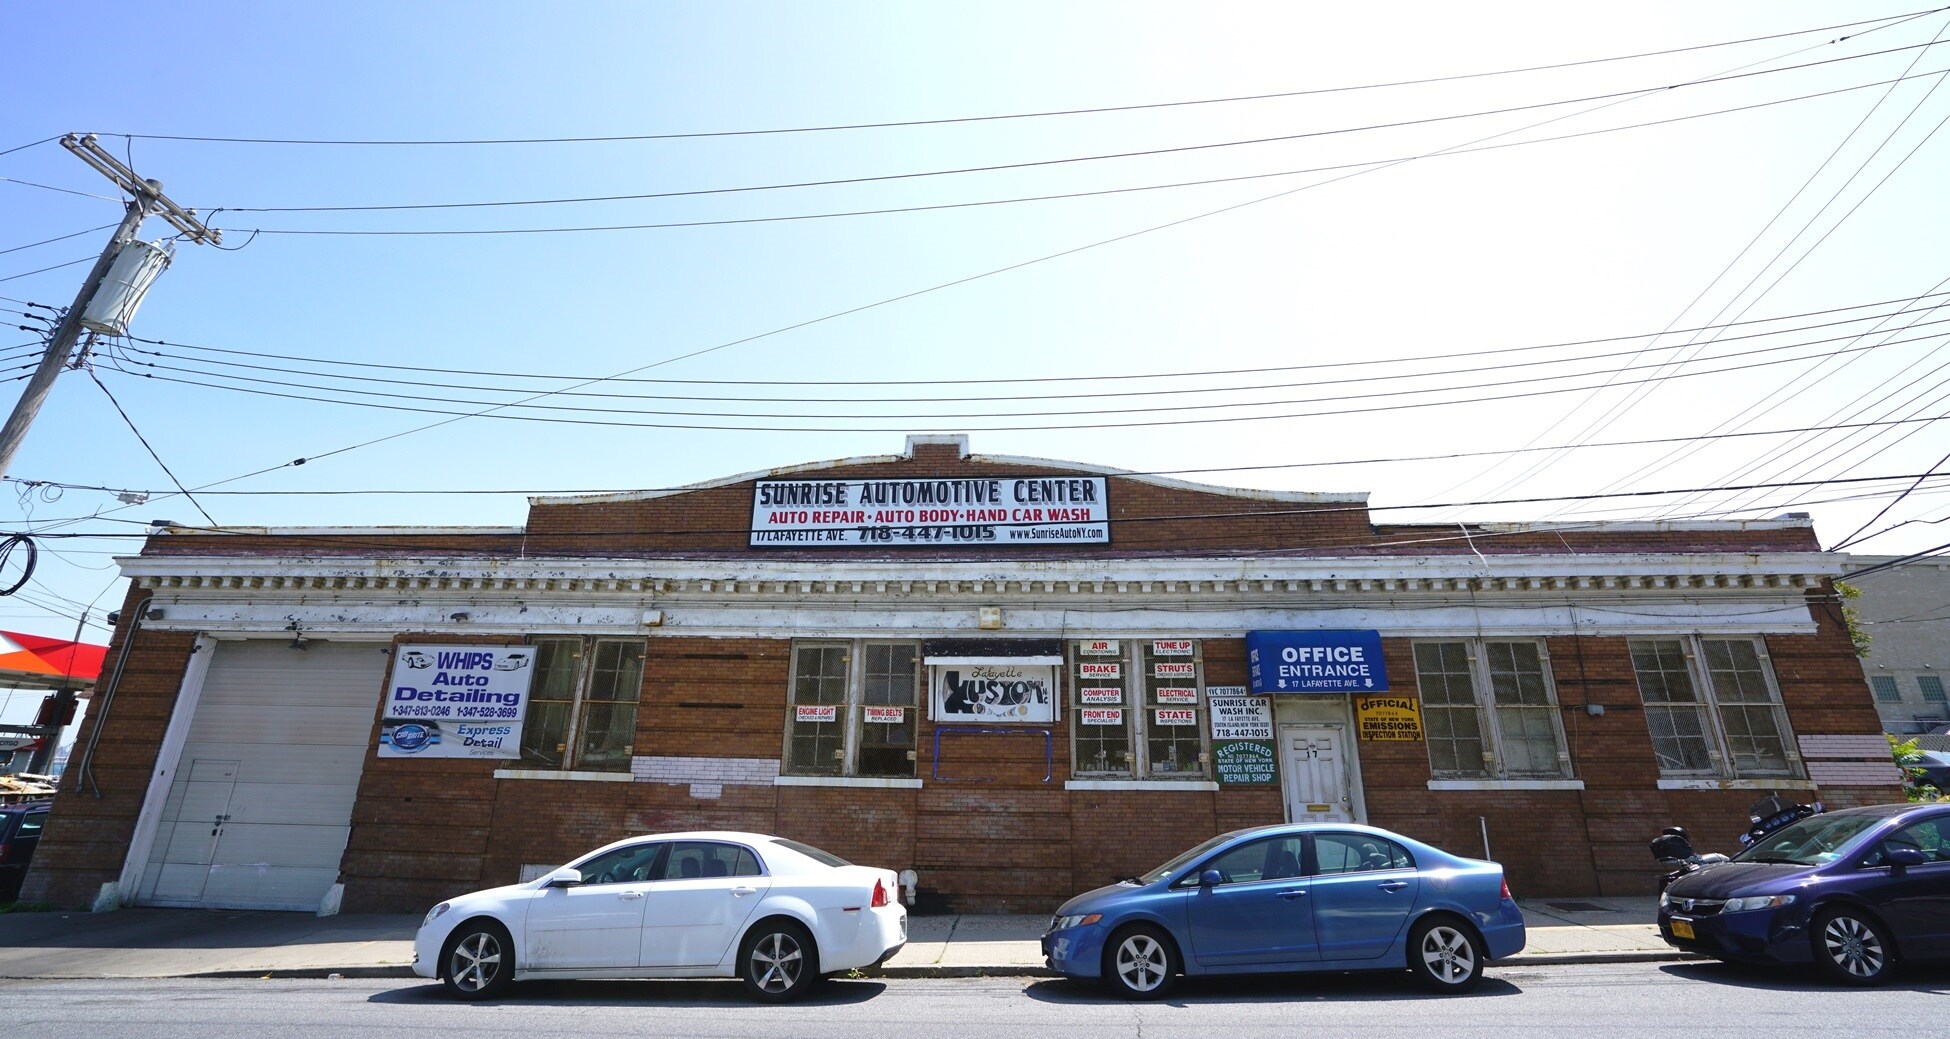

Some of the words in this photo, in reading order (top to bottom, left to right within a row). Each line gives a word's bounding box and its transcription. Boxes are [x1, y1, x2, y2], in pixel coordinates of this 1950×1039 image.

[760, 482, 847, 506] SUNRISE
[860, 480, 1001, 506] AUTOMOTIVE
[1014, 480, 1097, 504] CENTER
[768, 512, 808, 524] AUTO
[812, 510, 865, 524] REPAIR
[875, 510, 914, 523] AUTO
[919, 510, 959, 522] BODY
[966, 509, 1008, 522] HAND
[1012, 508, 1042, 521] CAR
[1048, 508, 1090, 521] WASH
[767, 530, 822, 541] LAFAYETTE
[826, 530, 848, 541] AVE.
[858, 525, 997, 542] 718-447-1015
[1010, 528, 1103, 540] www.SunriseAutoNY.com
[437, 651, 494, 670] WHIPS
[1282, 647, 1364, 662] OFFICE
[1280, 664, 1370, 677] ENTRANCE
[432, 672, 489, 686] Auto
[394, 687, 520, 706] Detailing
[392, 705, 450, 716] 1-347-813-0246
[457, 706, 517, 718] 1-347-528-3699
[1361, 700, 1415, 711] OFFICIAL
[457, 724, 511, 737] Express
[1363, 722, 1418, 730] EMISSIONS
[463, 737, 503, 748] Detail
[1217, 742, 1272, 758] REGISTERED
[1218, 765, 1242, 773] MOTOR
[1244, 764, 1274, 772] VEHICLE
[1224, 774, 1250, 782] REPAIR
[1252, 774, 1271, 782] SHOP
